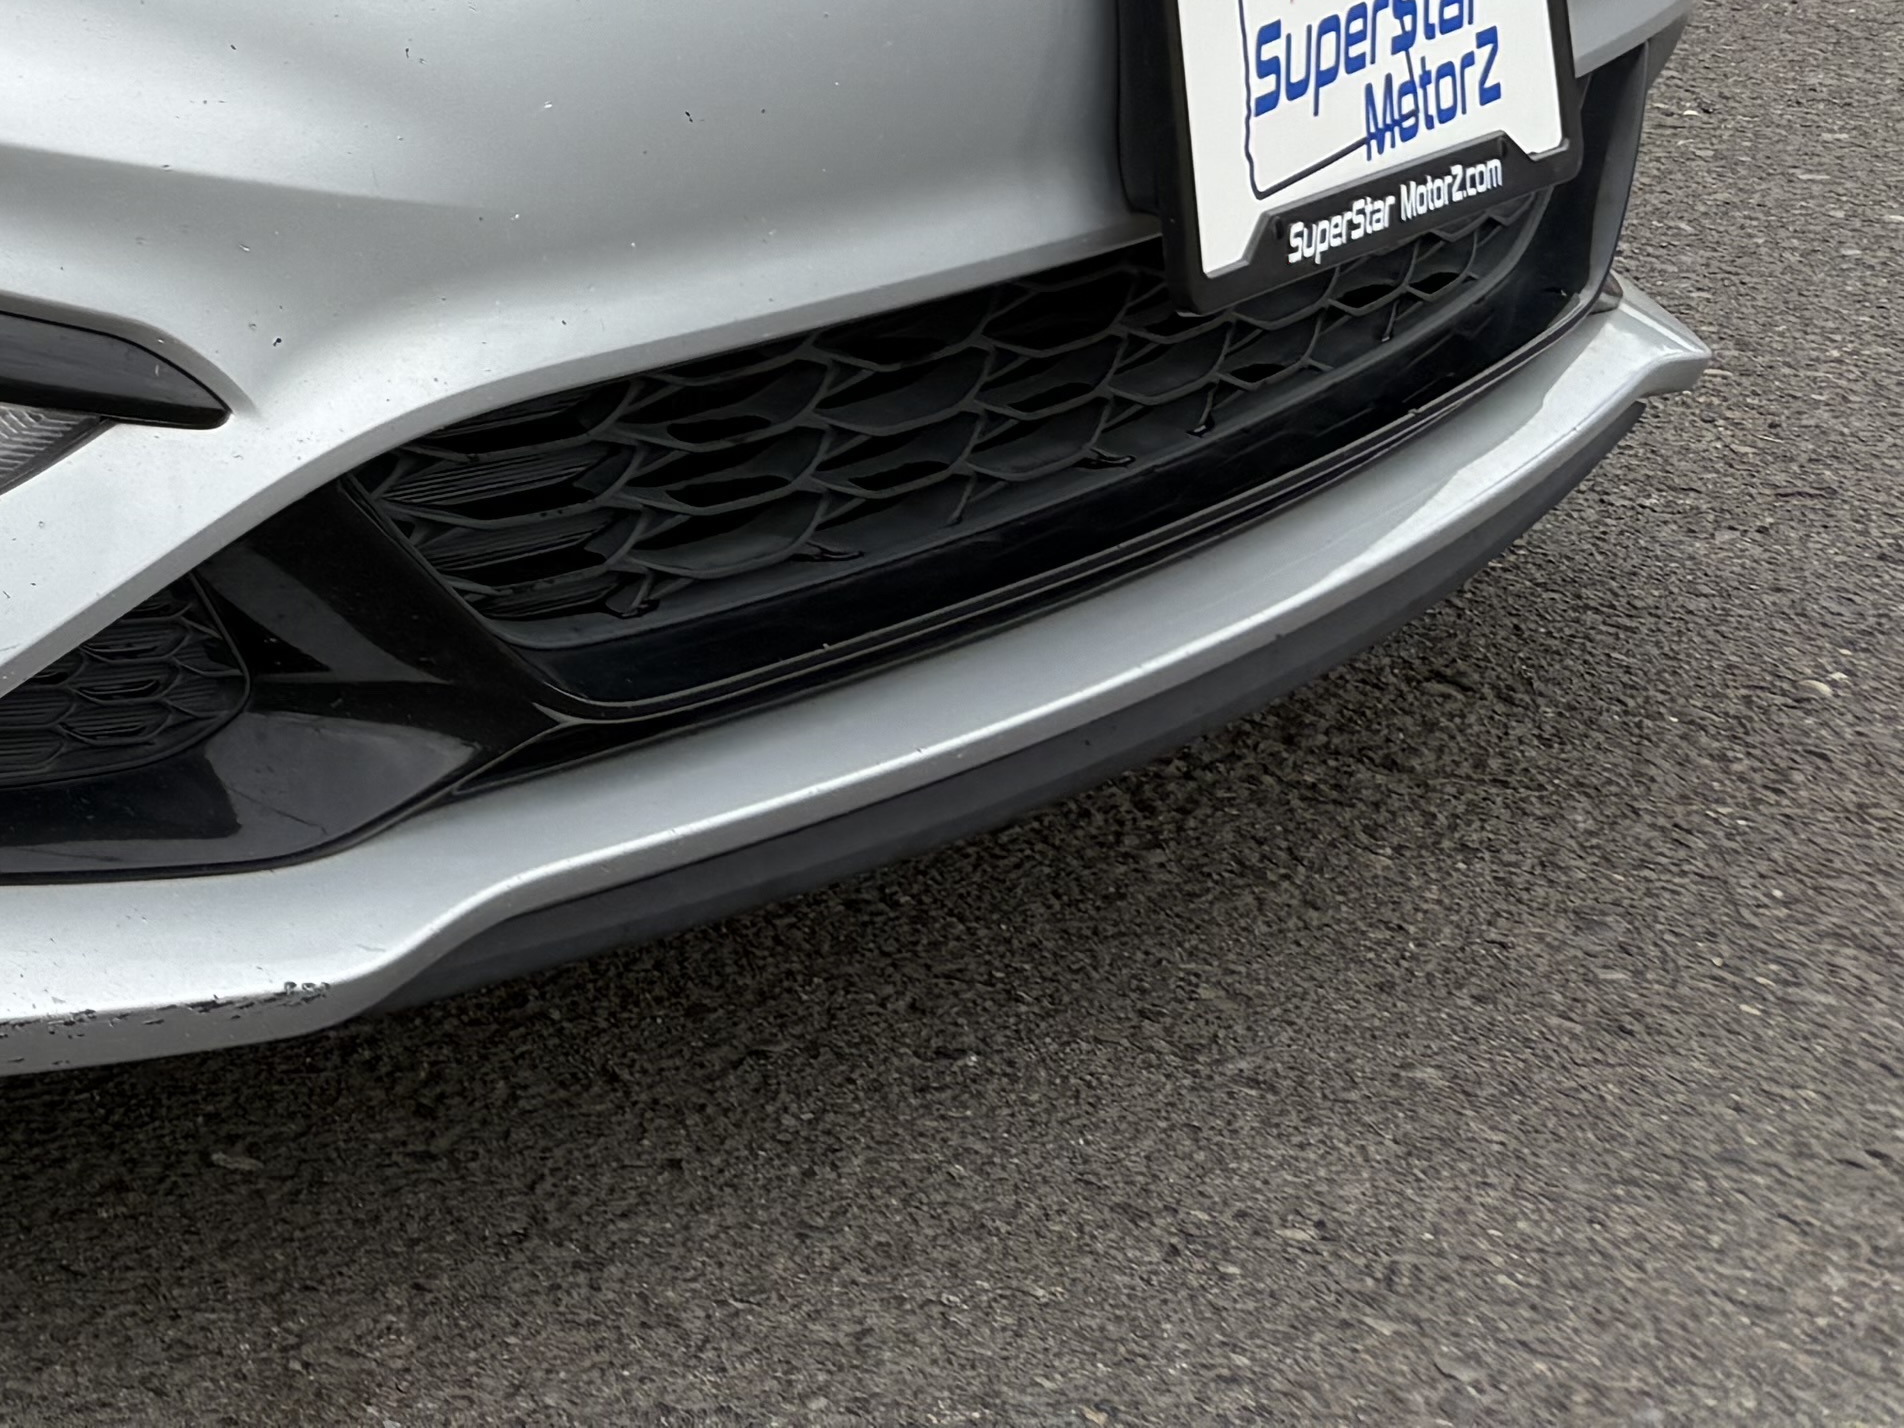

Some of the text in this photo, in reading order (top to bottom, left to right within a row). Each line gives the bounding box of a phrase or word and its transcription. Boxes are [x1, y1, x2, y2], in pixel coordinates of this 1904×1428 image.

[1364, 25, 1502, 162] MotorZ
[1287, 157, 1503, 265] SuperStar MotorZ.com
